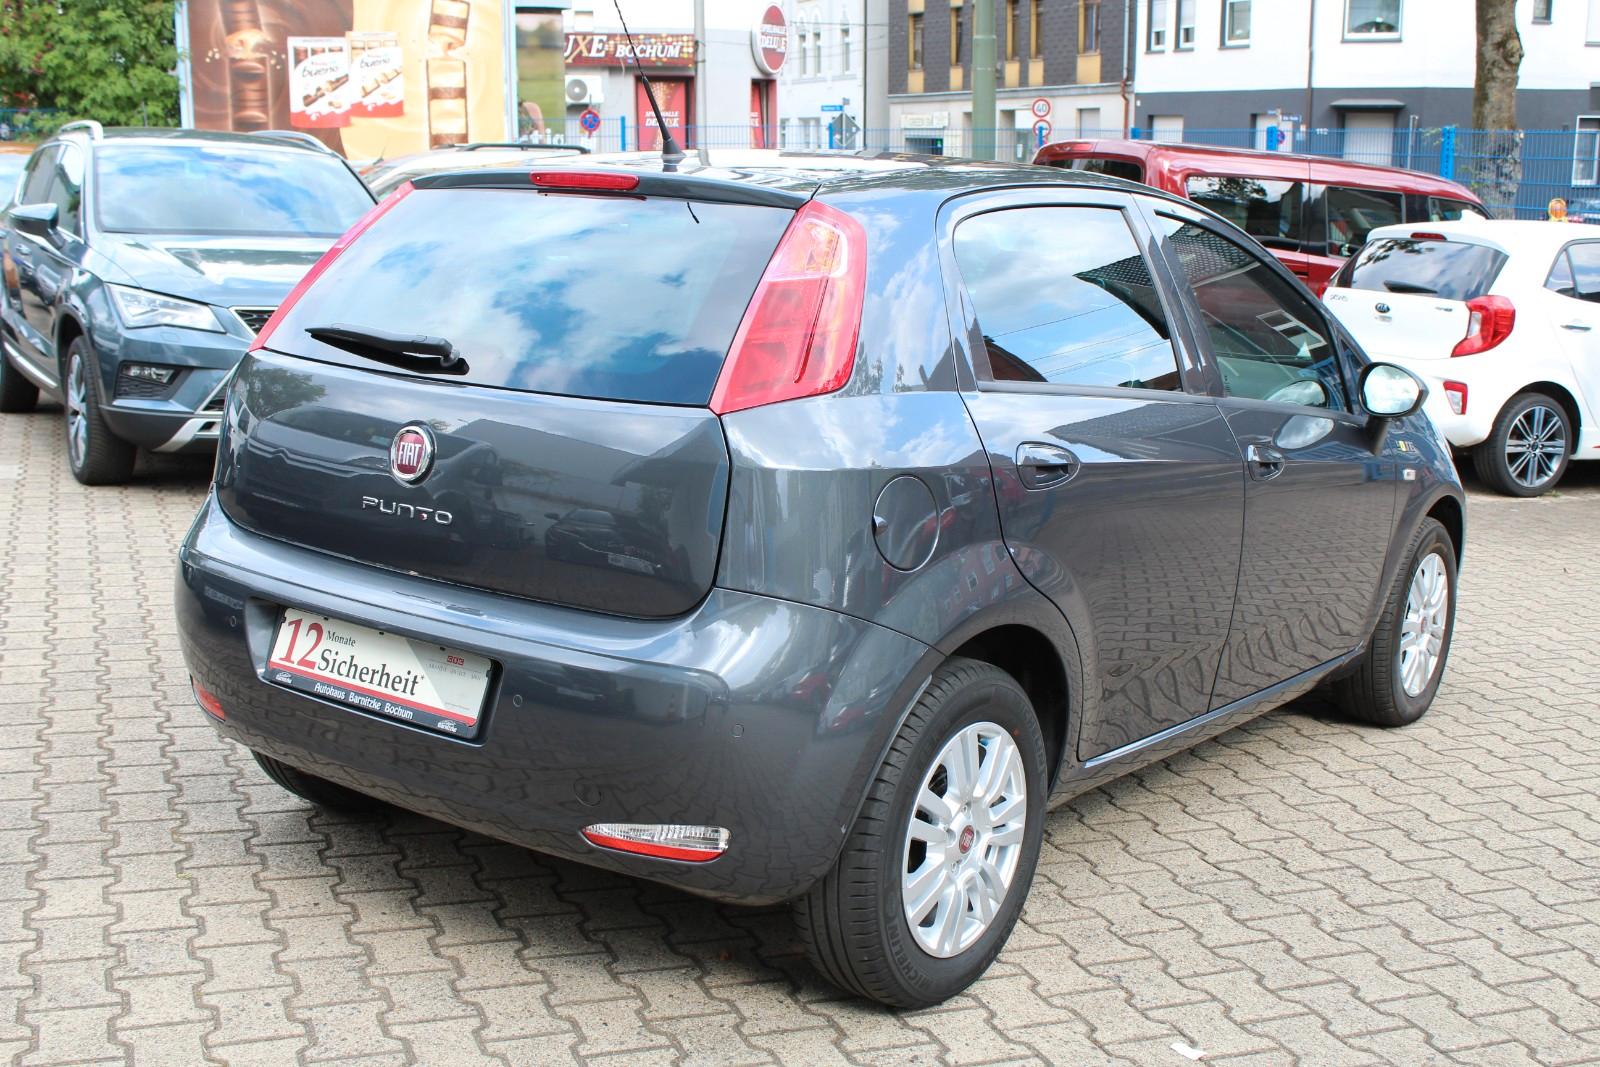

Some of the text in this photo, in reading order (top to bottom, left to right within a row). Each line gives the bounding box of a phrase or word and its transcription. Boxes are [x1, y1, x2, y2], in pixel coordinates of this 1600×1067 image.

[615, 42, 682, 58] BOCHUM
[302, 65, 339, 78] bueno
[397, 441, 422, 467] FIAT
[361, 495, 453, 526] PUNTO
[278, 617, 324, 671] 12
[326, 630, 356, 648] Monate
[314, 682, 413, 720] Autohaus Barnitzke Bochum
